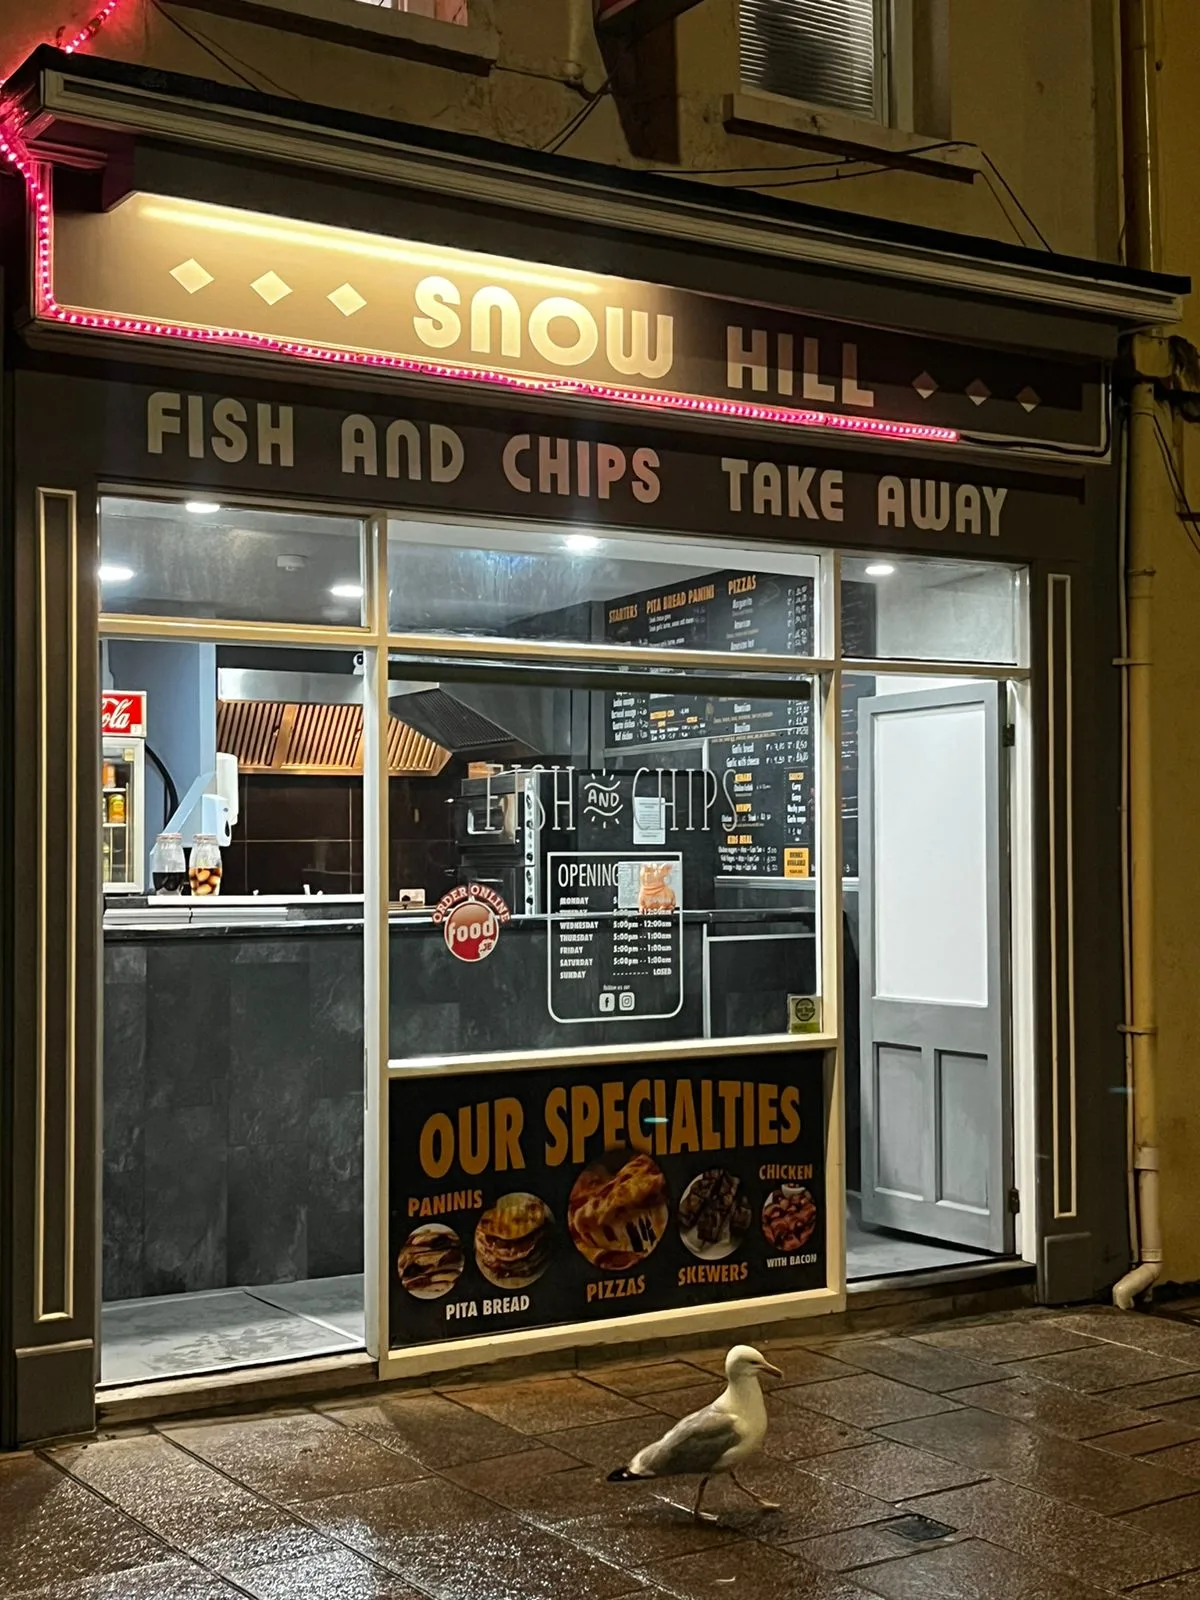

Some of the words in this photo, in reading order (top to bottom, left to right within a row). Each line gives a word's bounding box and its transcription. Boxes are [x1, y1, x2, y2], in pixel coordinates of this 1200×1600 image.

[414, 276, 673, 378] SNOW
[727, 326, 874, 407] HILL
[147, 391, 294, 467] FISH
[341, 414, 464, 483] AND
[503, 434, 661, 503] CHIPS
[721, 457, 843, 521] TAKE
[878, 475, 1008, 536] AWAY
[728, 574, 756, 595] PIZZAS
[646, 599, 661, 614] PITA
[663, 592, 686, 610] BREAD
[688, 584, 714, 604] PANINI
[608, 604, 638, 624] STARTERS
[588, 788, 619, 808] AND
[632, 766, 737, 831] CHIPS
[433, 886, 468, 923] ORDER
[471, 885, 511, 923] ONLINE
[560, 896, 590, 905] MONDAY
[448, 912, 495, 948] food
[560, 921, 599, 930] WEDNESDAY
[613, 921, 639, 930] 5:00pm
[643, 920, 672, 928] 12:00am
[560, 933, 594, 942] THURSDAY
[613, 932, 639, 942] 5:00pm
[647, 932, 672, 940] 1:00am
[560, 946, 584, 955] FRIDAY
[613, 944, 639, 954] 5:00pm
[647, 944, 672, 952] 1:00am
[560, 958, 594, 967] SATURDAY
[613, 957, 639, 966] 5:00pm
[647, 956, 672, 964] 1:00am
[560, 970, 587, 979] SUNDAY
[419, 1097, 526, 1179] OUR
[544, 1079, 801, 1166] SPECIALTIES
[759, 1163, 813, 1181] CHICKEN
[407, 1189, 483, 1218] PANINIS
[766, 1257, 788, 1268] WITH
[789, 1253, 817, 1266] BACON
[678, 1262, 748, 1287] SKEWERS
[586, 1276, 646, 1302] PIZZAS
[445, 1299, 478, 1320] PITA
[482, 1295, 530, 1316] BREAD
